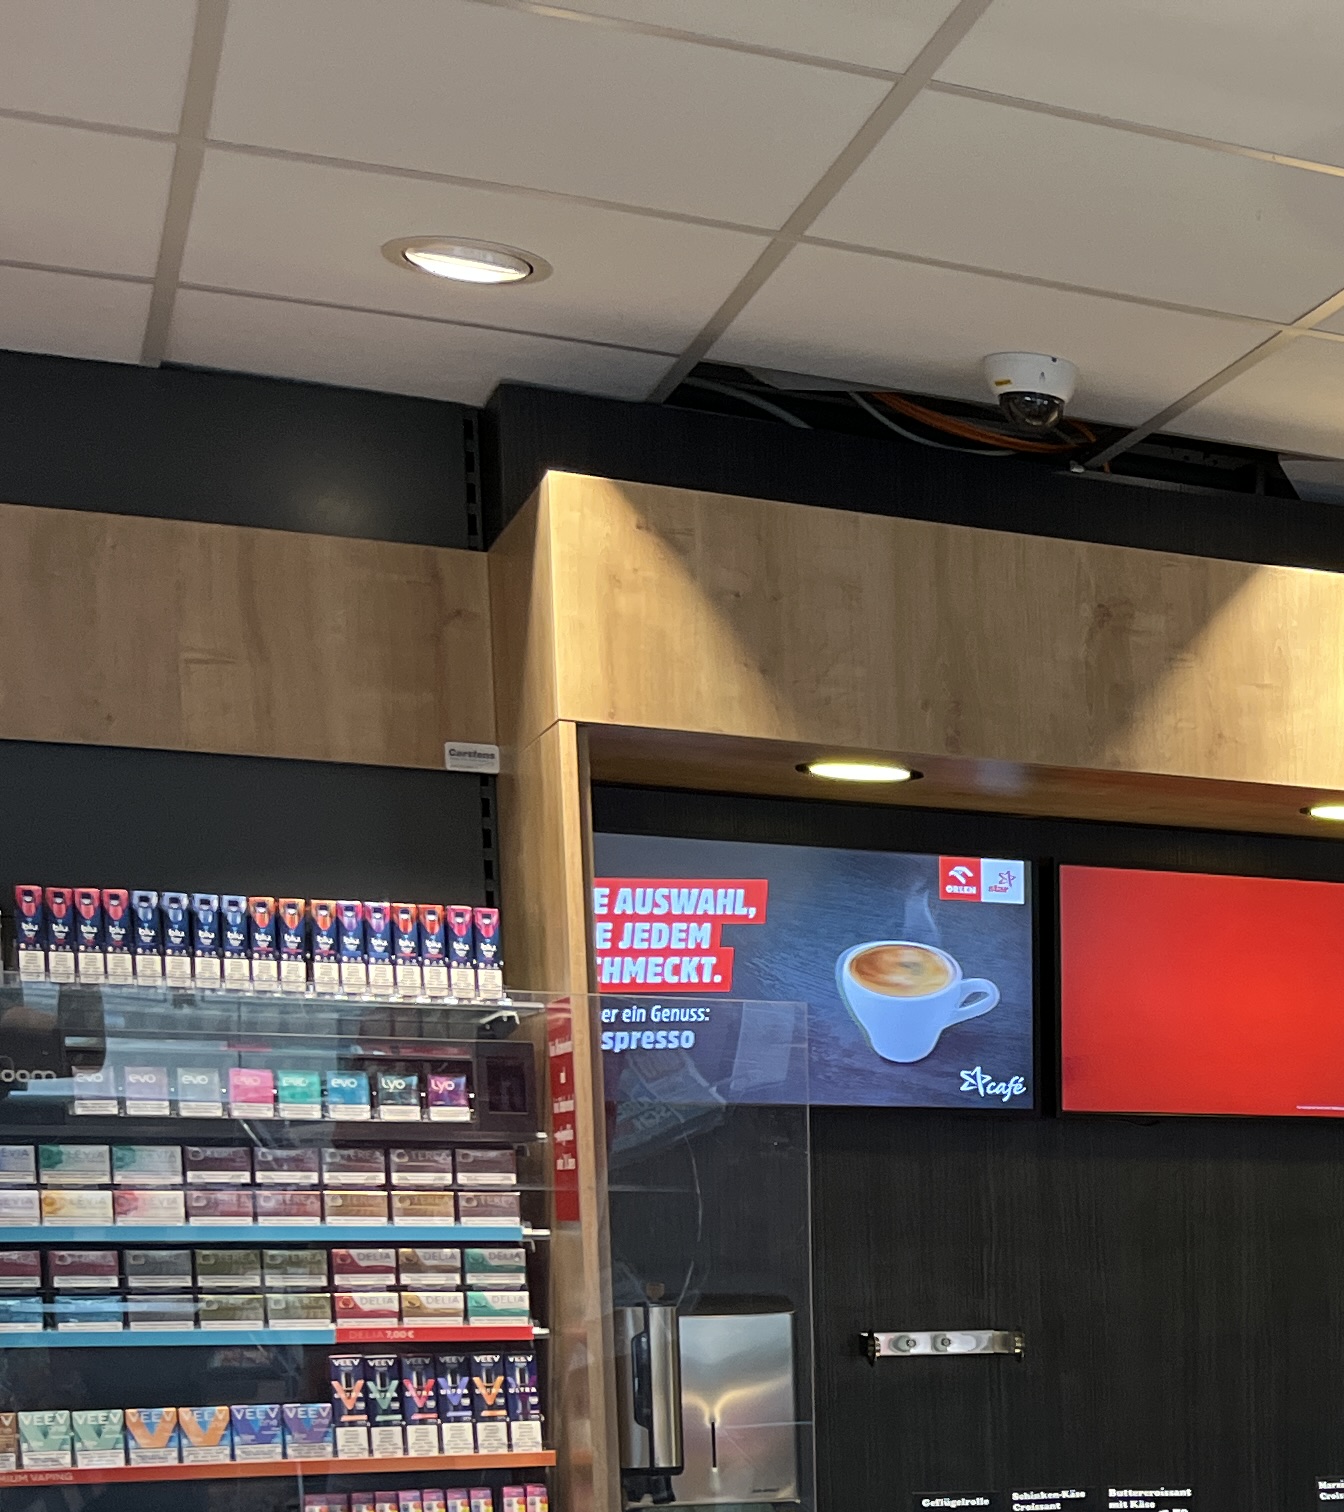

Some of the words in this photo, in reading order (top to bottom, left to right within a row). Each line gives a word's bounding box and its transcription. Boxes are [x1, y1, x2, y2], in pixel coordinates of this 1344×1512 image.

[945, 885, 977, 895] ORLEN
[614, 888, 757, 918] AUSWAHL,
[618, 923, 710, 949] JEDEM
[596, 956, 722, 983] HMECKT.
[622, 1006, 647, 1022] ein
[650, 1007, 710, 1024] Genuss:
[181, 1074, 208, 1085] evo
[331, 1078, 357, 1088] evo
[356, 1251, 392, 1262] DELIA
[360, 1295, 396, 1306] DELIA
[491, 1294, 525, 1305] DELIA
[21, 1411, 69, 1426] VEEV
[74, 1411, 122, 1426] VEEV
[31, 1472, 74, 1483] VAPING
[1012, 1489, 1086, 1501] Schinken-Käse
[1108, 1486, 1192, 1498] Buttercroissant
[921, 1498, 990, 1508] Geflügelrolle
[1012, 1502, 1061, 1512] Croissant
[1108, 1500, 1128, 1510] mit
[1129, 1499, 1156, 1510] Käse
